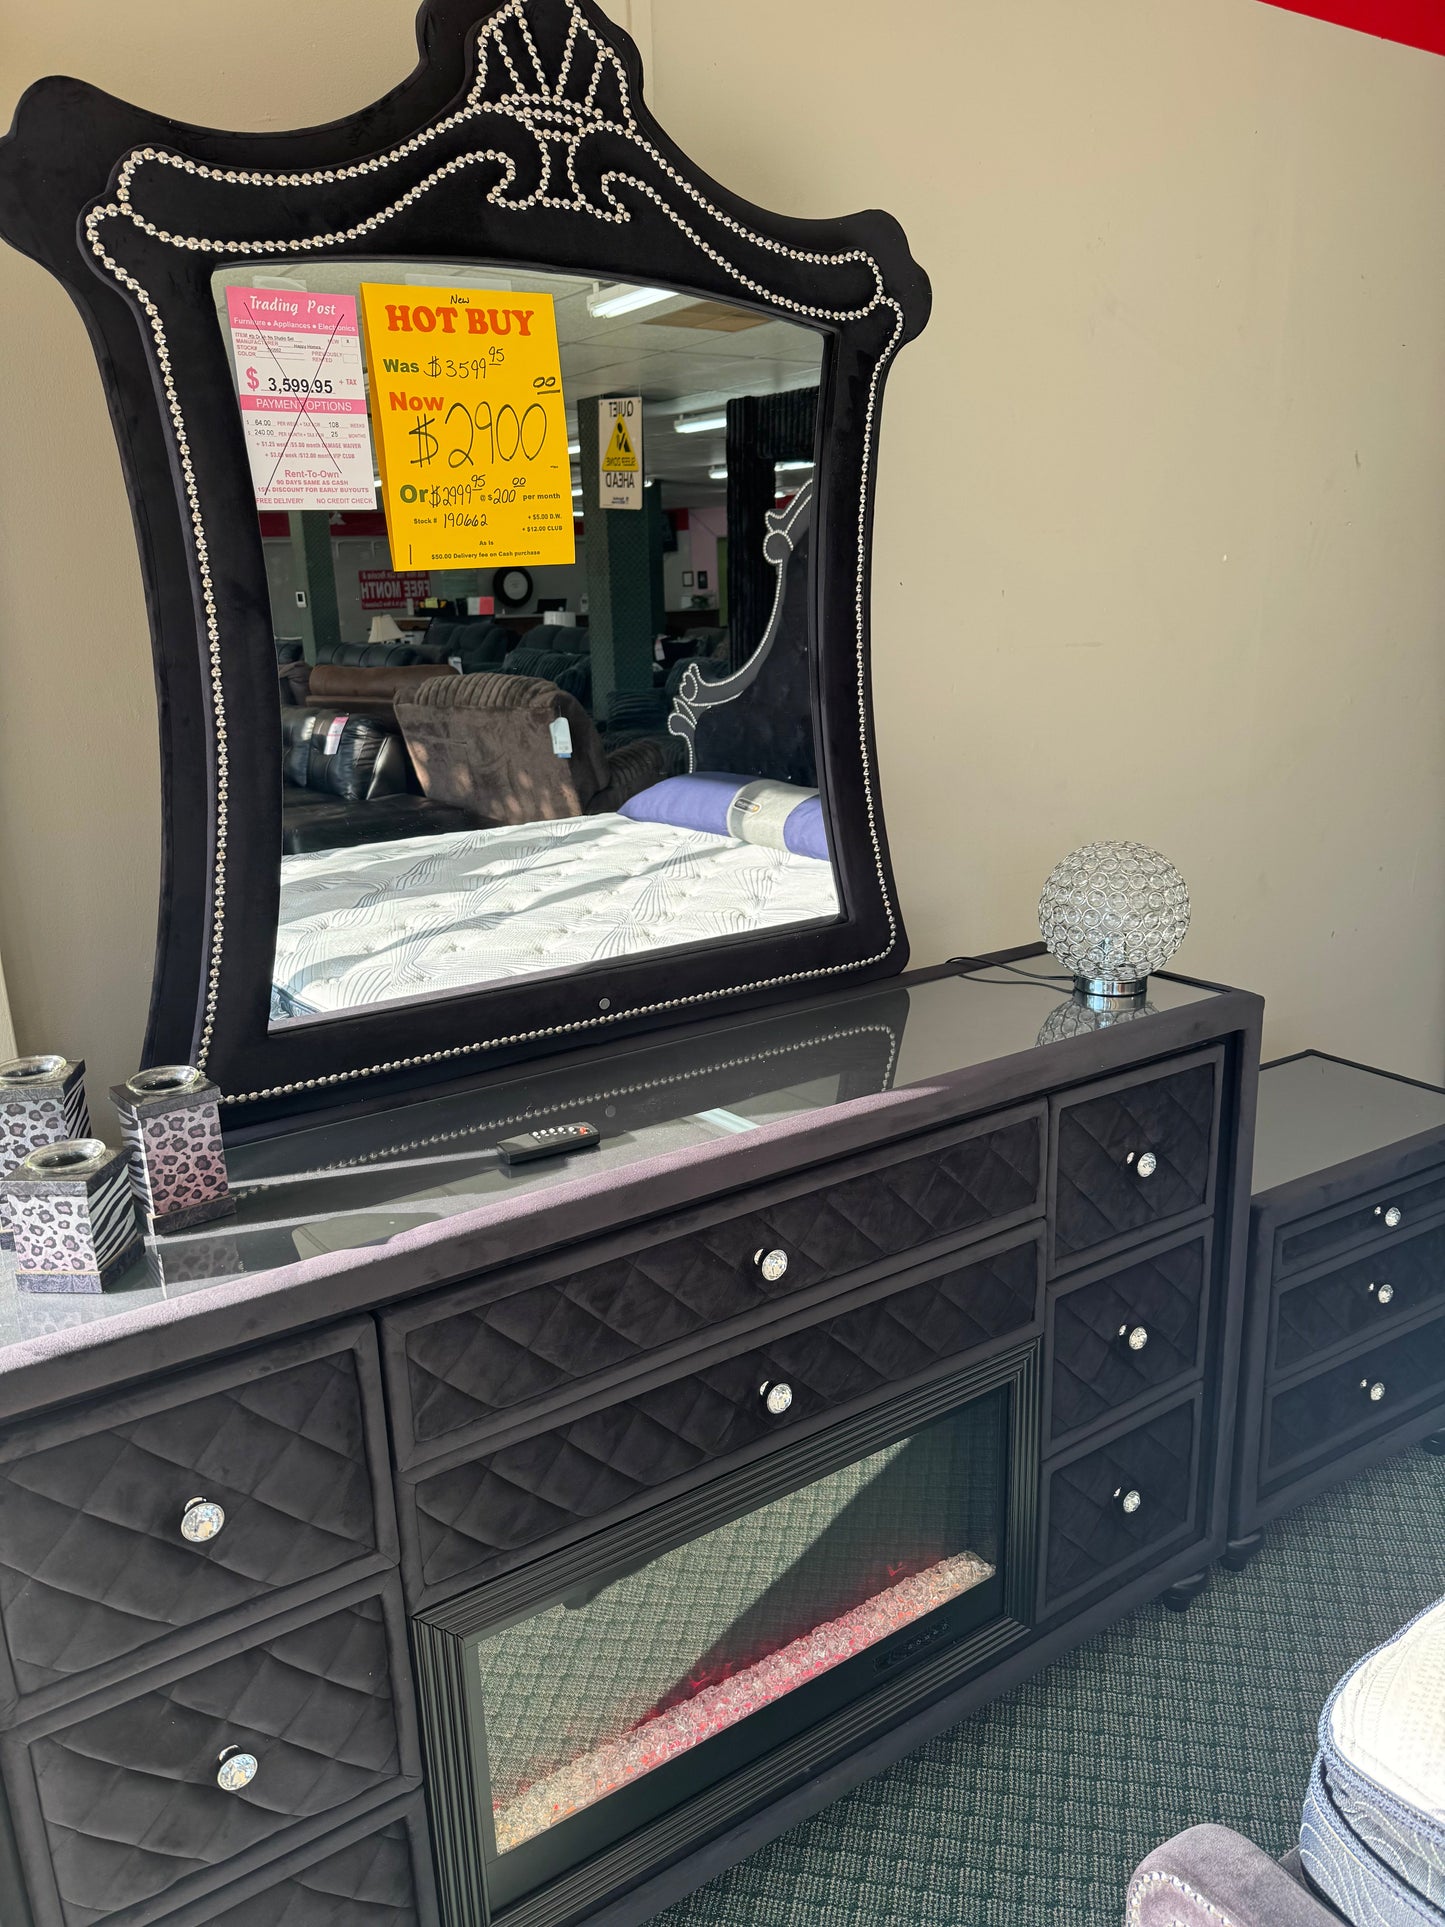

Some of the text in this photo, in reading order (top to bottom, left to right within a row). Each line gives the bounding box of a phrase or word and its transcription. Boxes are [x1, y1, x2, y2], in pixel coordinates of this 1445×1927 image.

[250, 296, 336, 316] Trading Post
[450, 294, 470, 304] New
[273, 320, 311, 330] Appliances
[385, 304, 534, 336] HOT BUY
[383, 358, 419, 373] Was
[246, 366, 259, 391] $
[268, 377, 333, 394] 3,599.95
[306, 400, 352, 411] OPTIONS
[389, 392, 444, 410] Now
[409, 401, 547, 468] $2900
[284, 470, 339, 478] Rent-To-Own
[400, 484, 428, 503] Or
[444, 513, 488, 528] 190662
